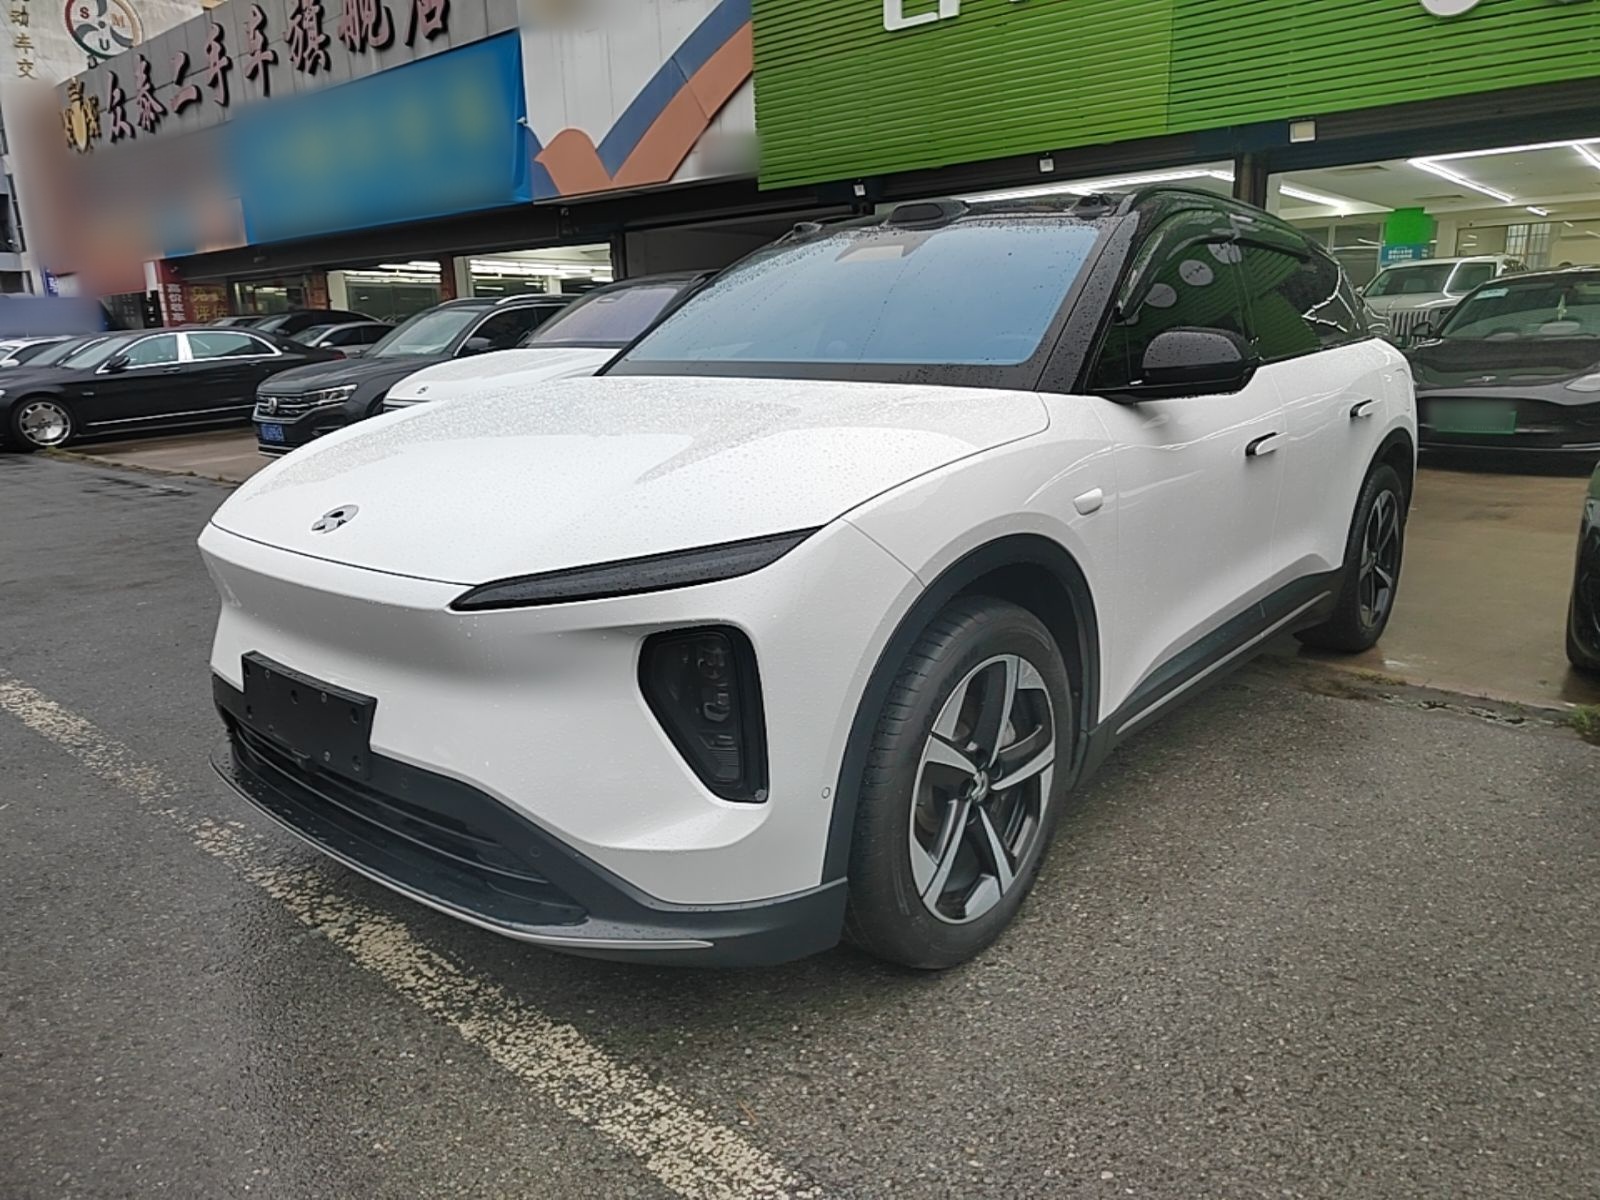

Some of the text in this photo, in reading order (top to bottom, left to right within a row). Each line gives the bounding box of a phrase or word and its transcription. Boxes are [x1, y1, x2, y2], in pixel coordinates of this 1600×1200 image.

[80, 6, 90, 19] S
[9, 0, 38, 80] 动车交
[98, 38, 111, 51] U
